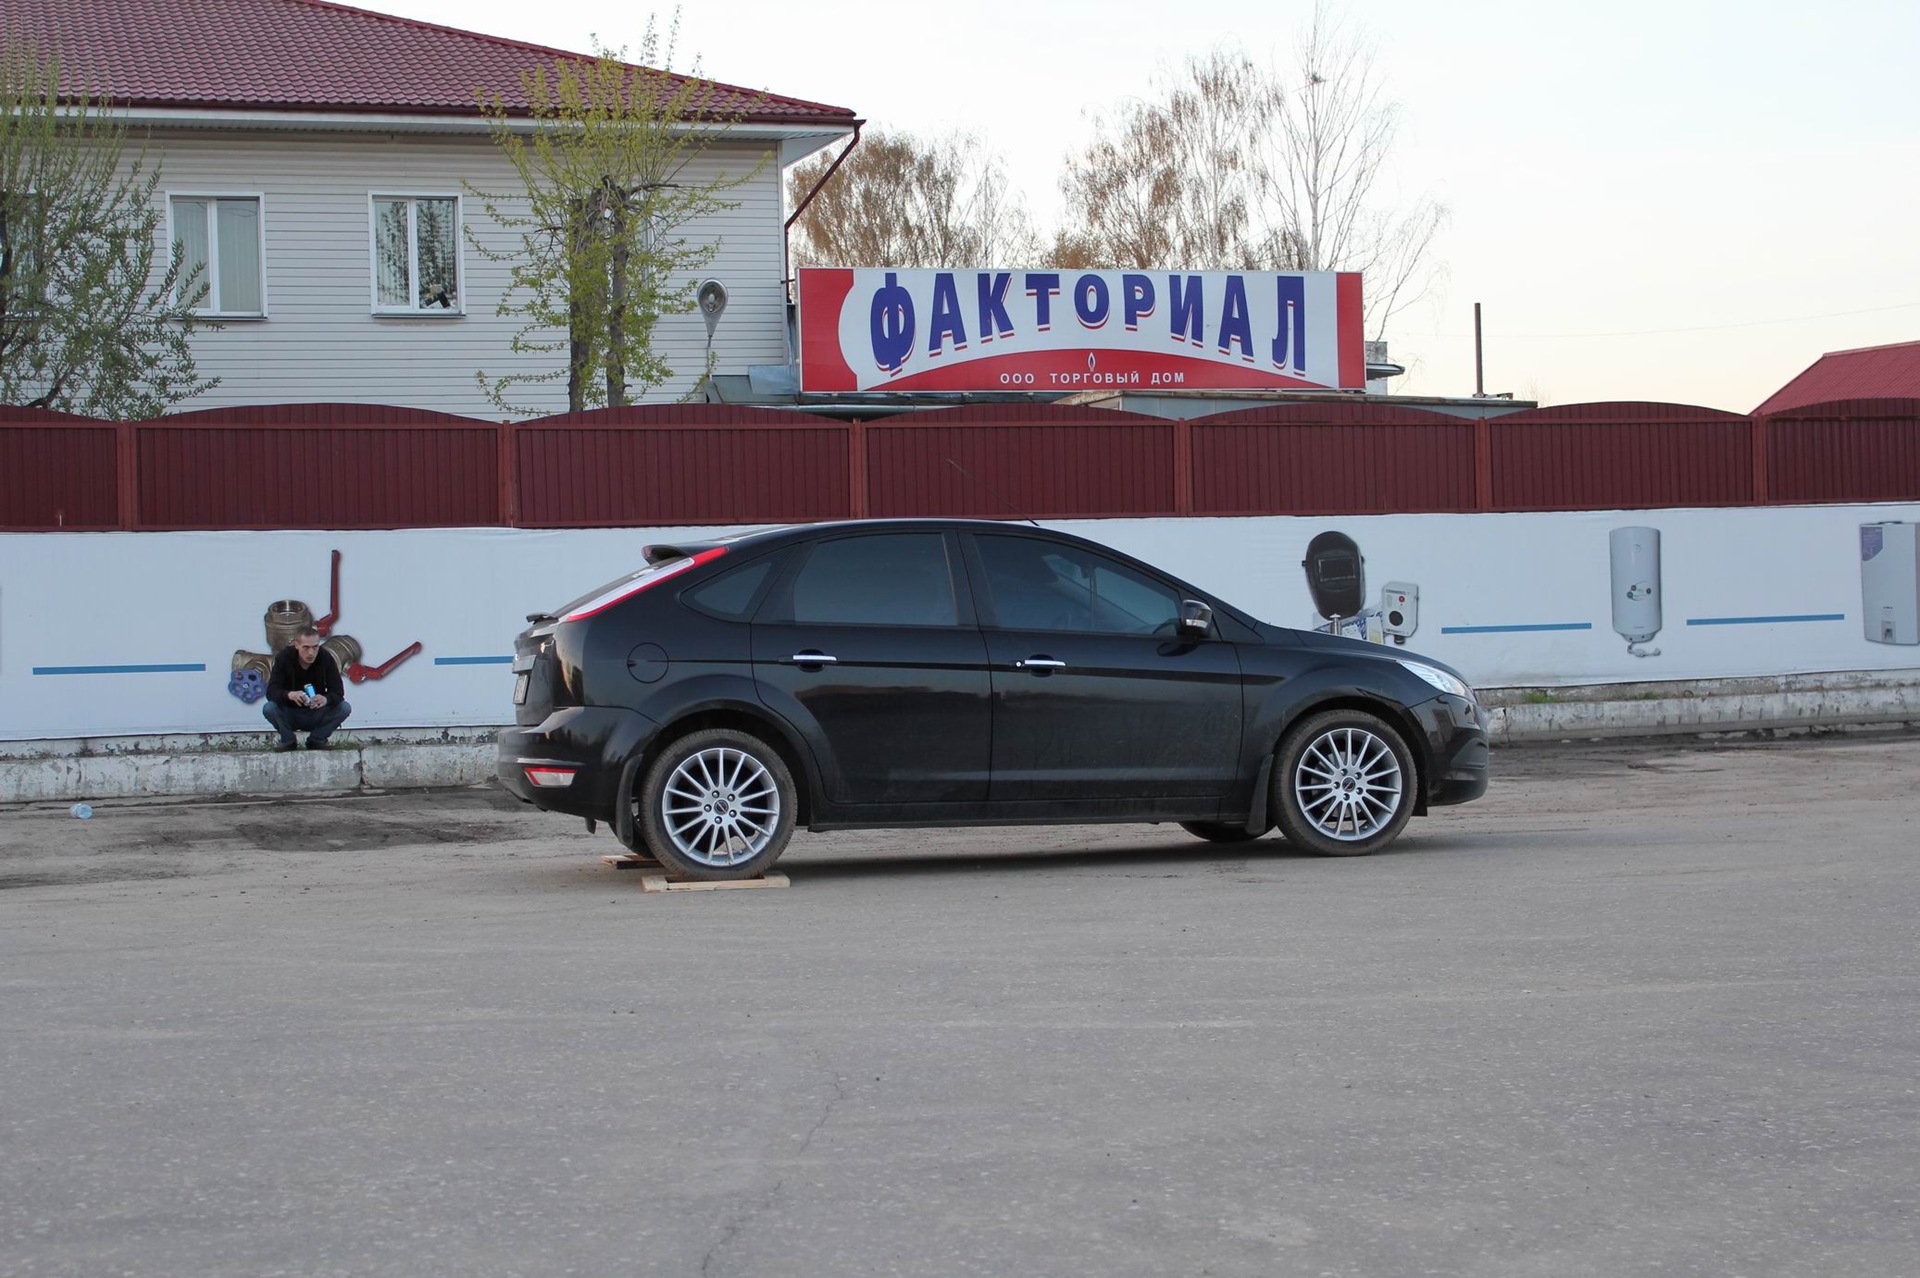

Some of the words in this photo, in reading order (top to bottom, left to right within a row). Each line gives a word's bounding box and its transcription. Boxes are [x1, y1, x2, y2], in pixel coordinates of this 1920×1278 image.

[870, 272, 1304, 376] ФАКТОРИАЛ
[1000, 373, 1035, 384] ООО
[1049, 370, 1139, 384] ТОРГОВЫЙ
[1150, 372, 1184, 385] ДОМ
